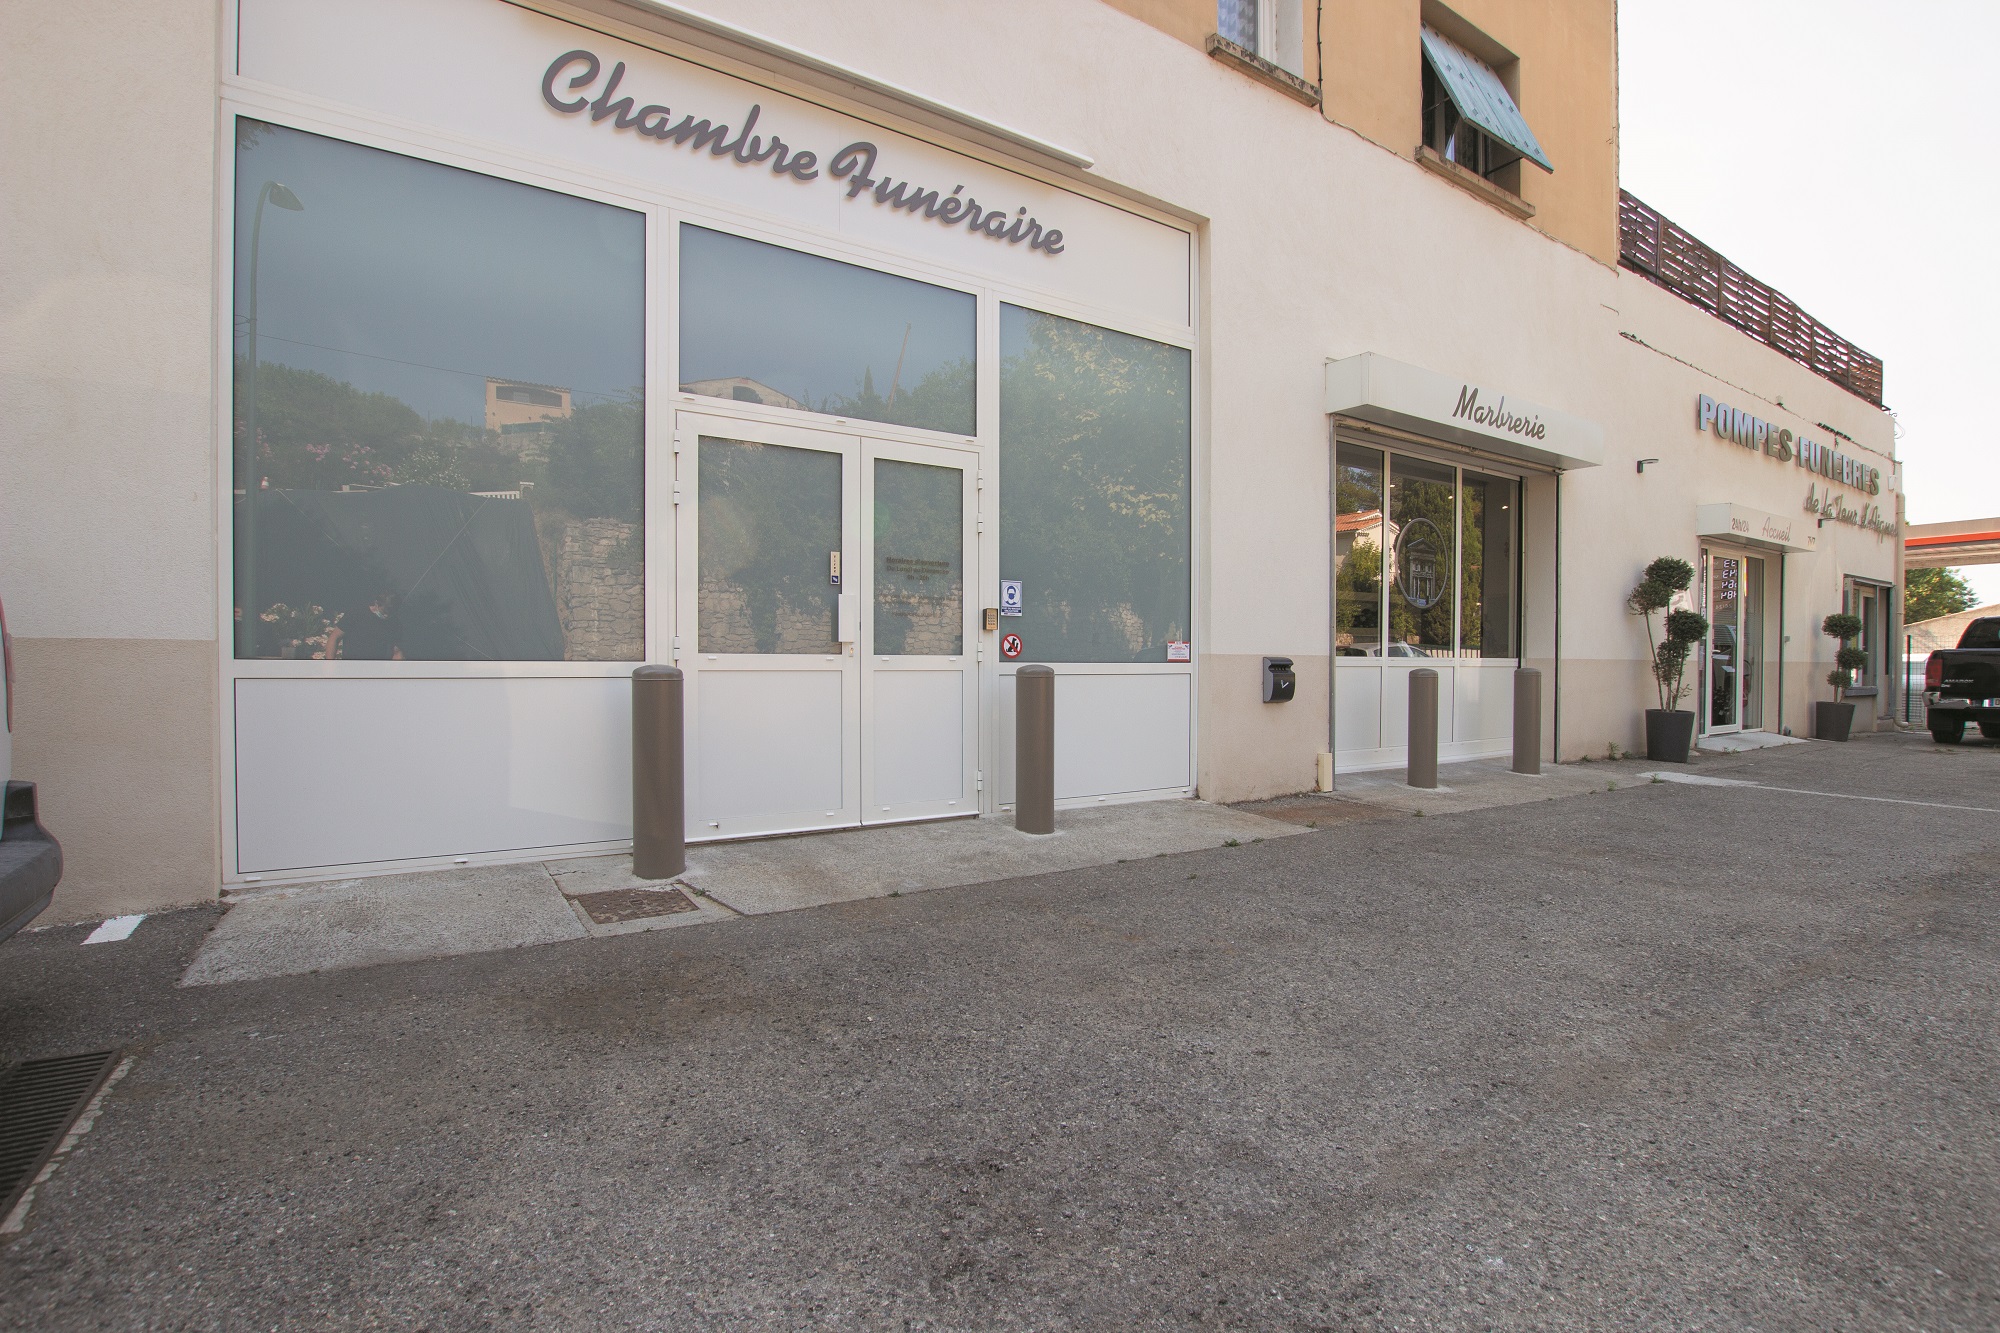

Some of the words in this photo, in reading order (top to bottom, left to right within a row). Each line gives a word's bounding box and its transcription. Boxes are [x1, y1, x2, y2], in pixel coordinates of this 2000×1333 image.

[542, 50, 819, 182] Chambre
[831, 142, 1065, 255] Funéraire
[1452, 384, 1546, 440] Marbrerie
[1699, 393, 1793, 462] POMPES
[1803, 482, 1819, 514] de
[1821, 487, 1833, 518] la
[1761, 516, 1792, 543] Accueil
